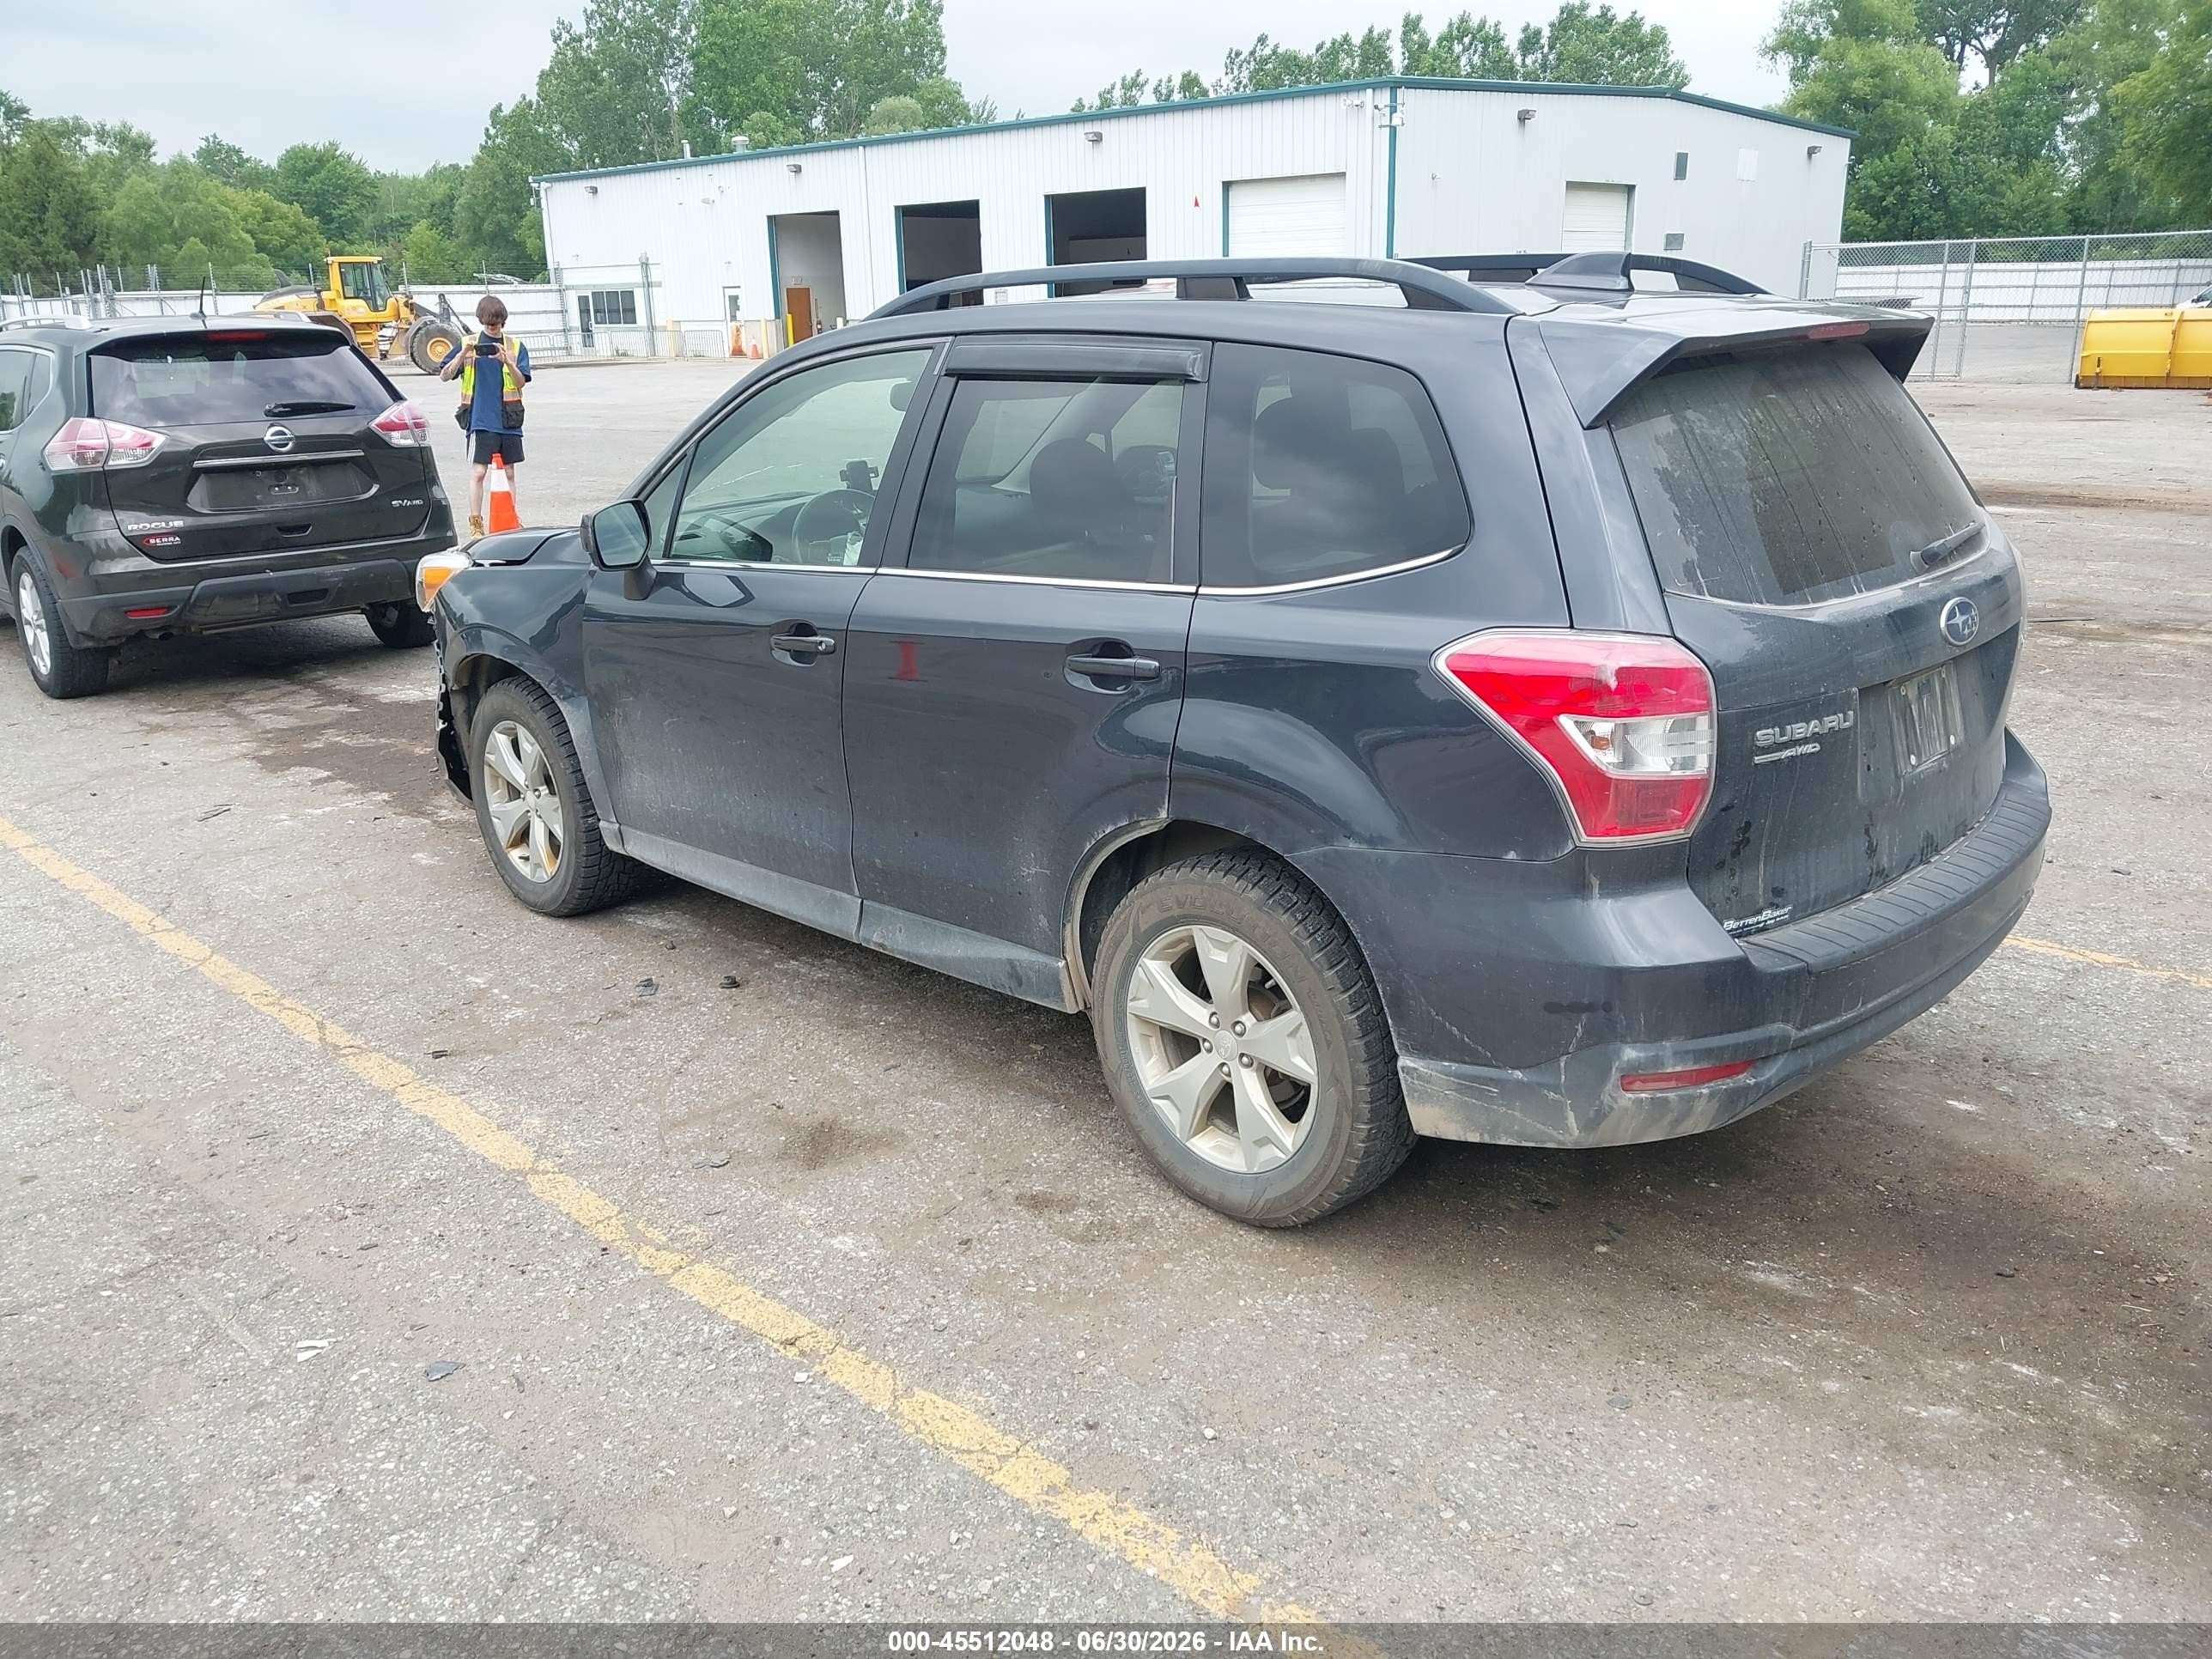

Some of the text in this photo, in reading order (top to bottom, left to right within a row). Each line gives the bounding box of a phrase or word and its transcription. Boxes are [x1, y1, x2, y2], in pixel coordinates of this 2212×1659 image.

[127, 520, 185, 532] ROGUE
[149, 535, 181, 544] SERRA
[1755, 710, 1854, 747] SUBARU
[1780, 743, 1820, 759] AWD
